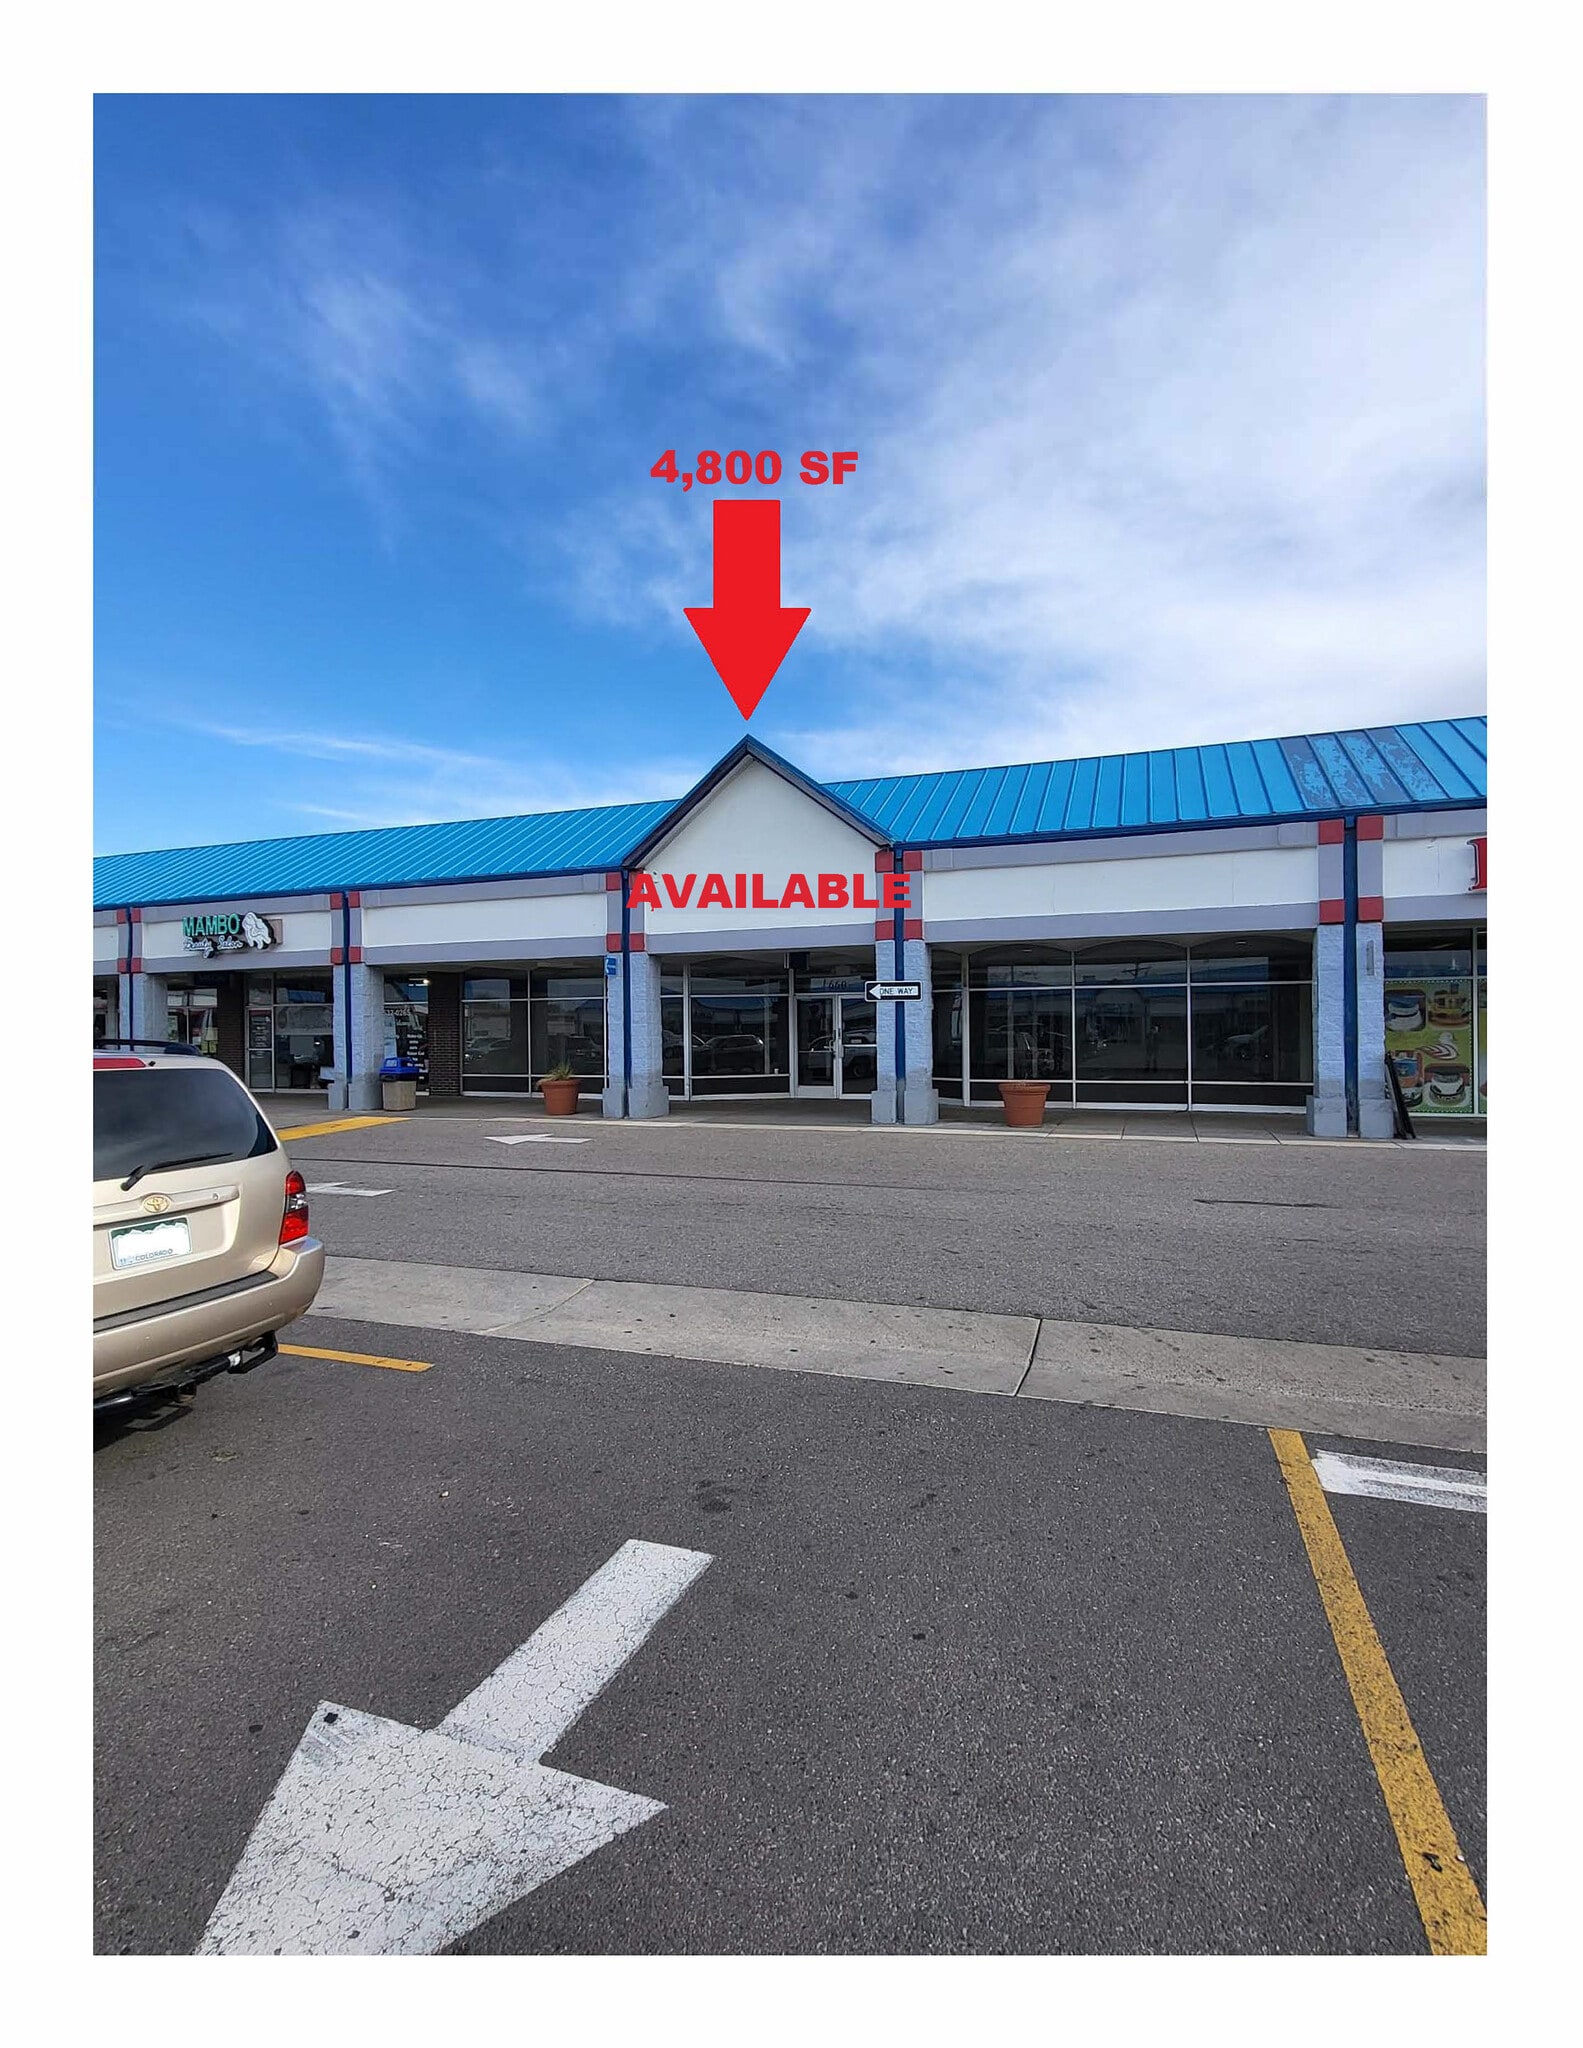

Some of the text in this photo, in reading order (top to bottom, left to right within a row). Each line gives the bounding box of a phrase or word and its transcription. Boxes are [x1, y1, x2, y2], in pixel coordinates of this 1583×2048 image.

[182, 913, 240, 936] MAMBO
[217, 935, 243, 950] Salon
[879, 987, 914, 995] ONE WAY
[135, 1248, 173, 1262] COLORADO
